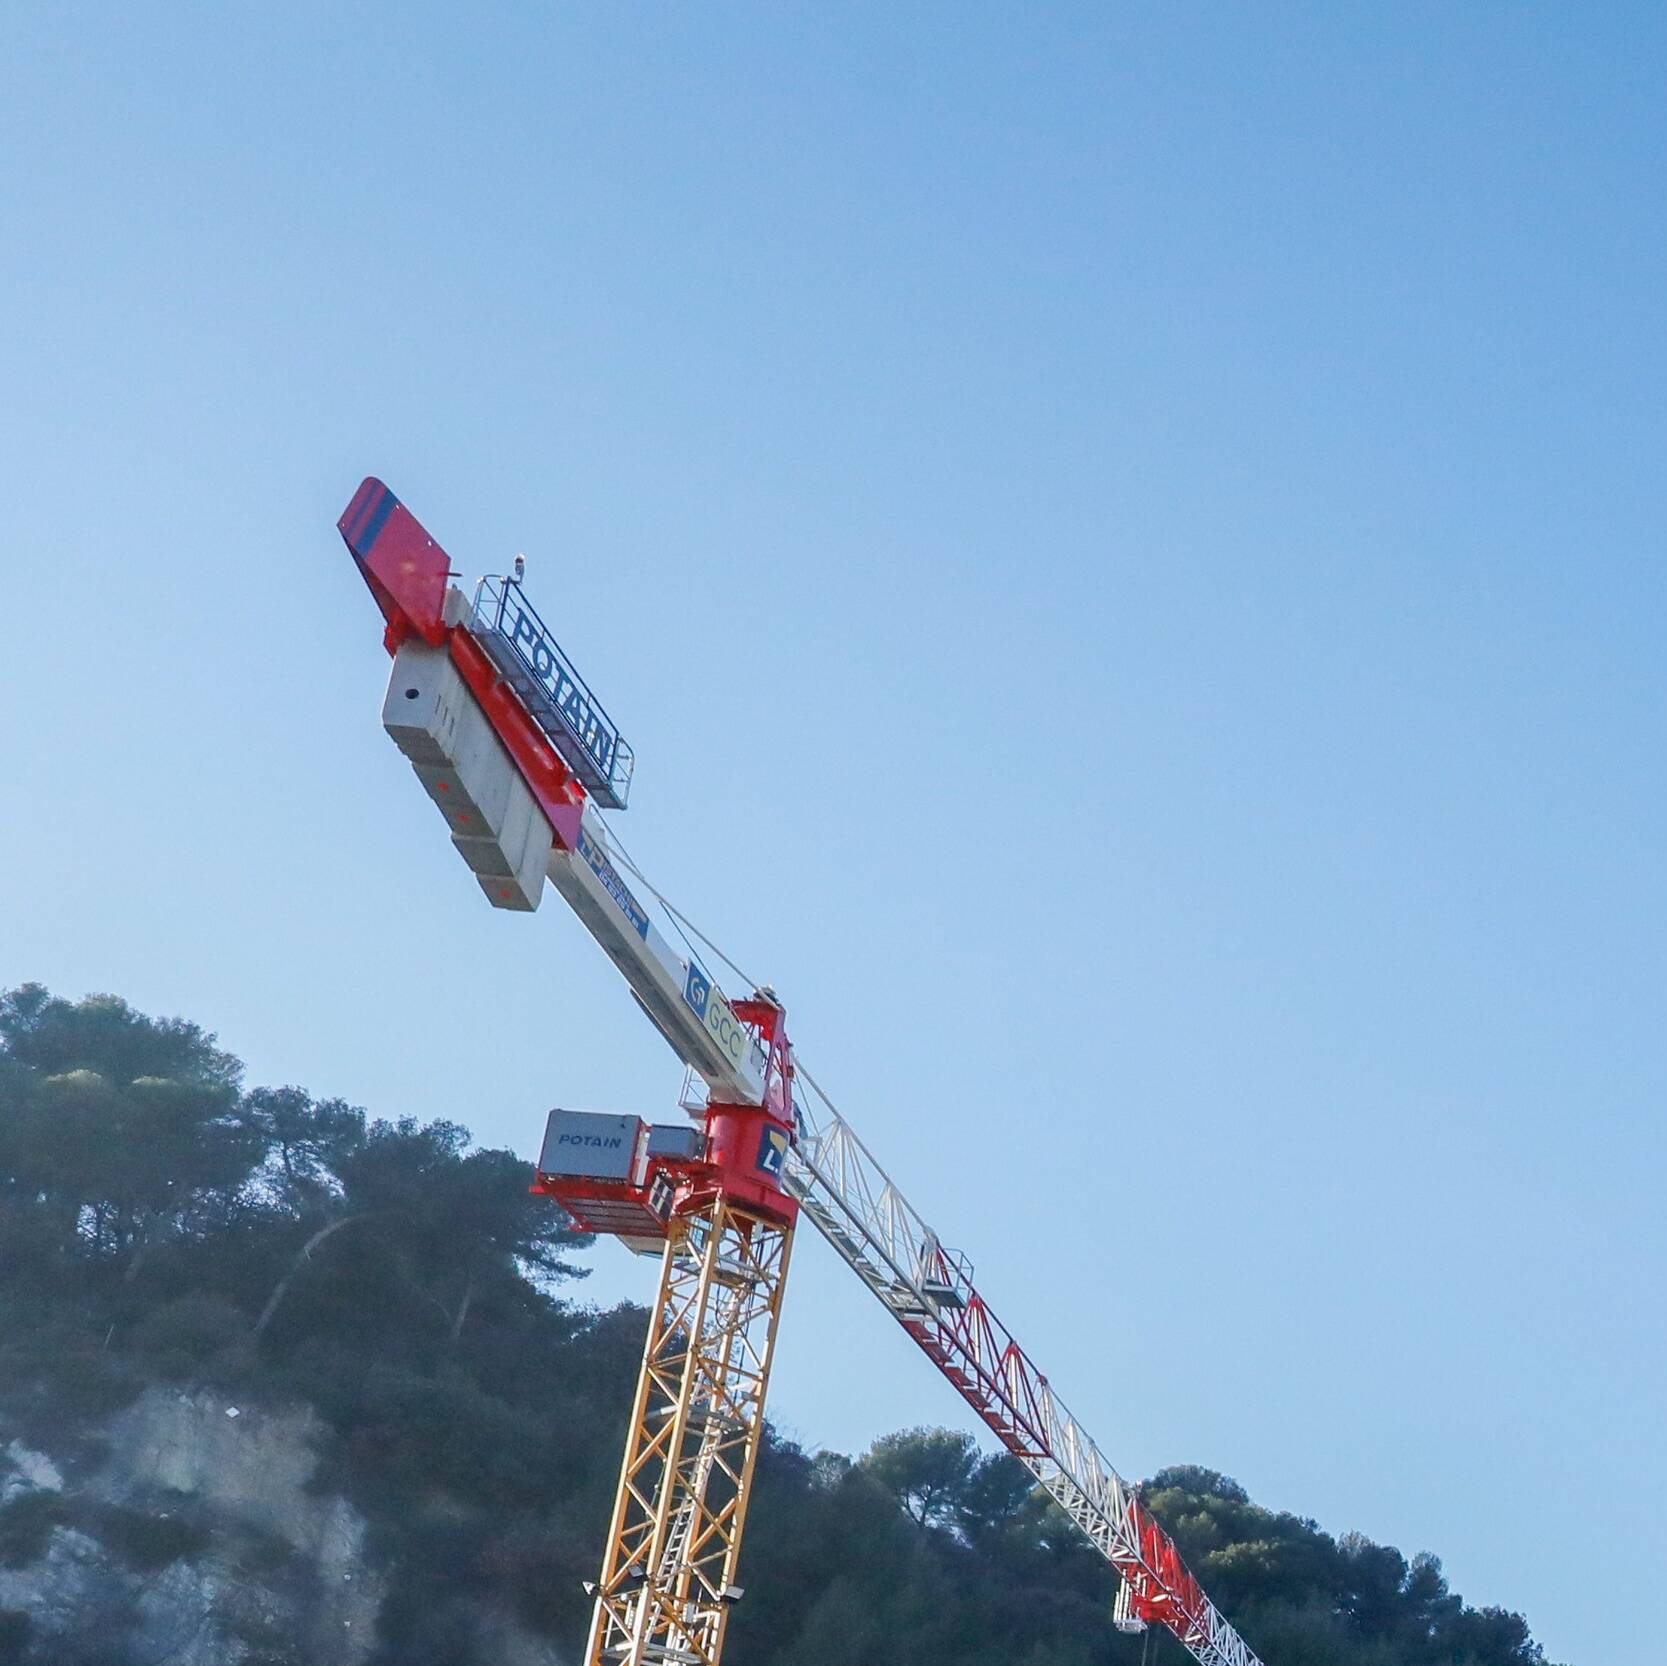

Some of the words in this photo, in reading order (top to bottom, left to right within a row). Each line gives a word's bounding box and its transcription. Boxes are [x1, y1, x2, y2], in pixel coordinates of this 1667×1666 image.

[510, 607, 613, 765] POTAIN
[708, 1003, 742, 1058] GCC
[558, 1133, 622, 1150] POTAIN
